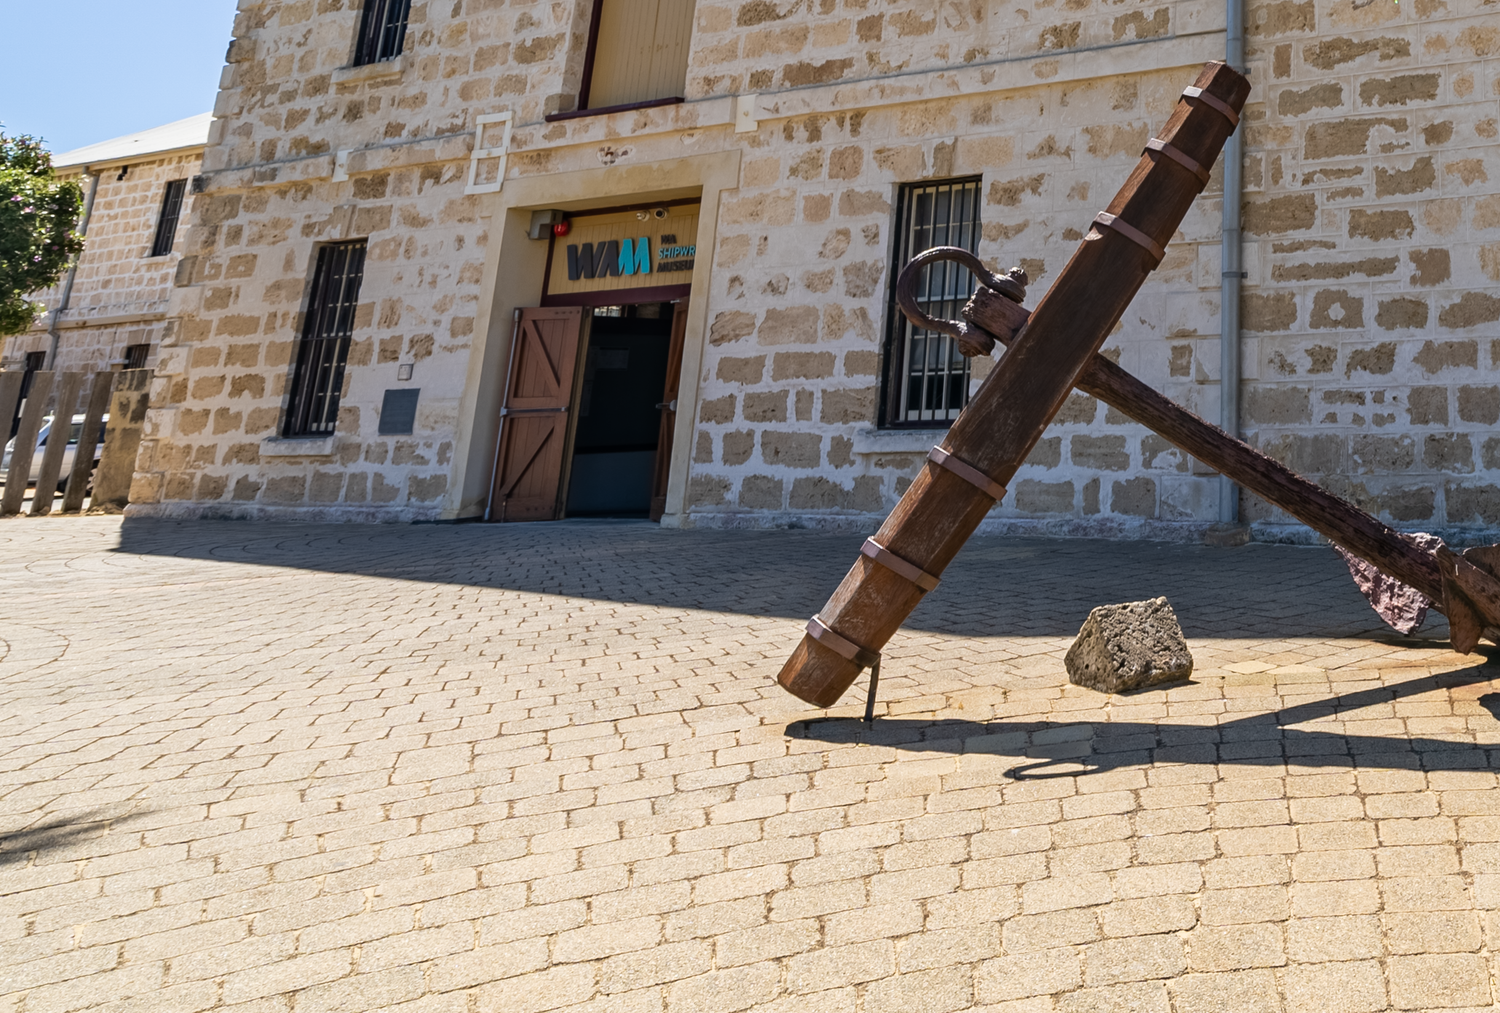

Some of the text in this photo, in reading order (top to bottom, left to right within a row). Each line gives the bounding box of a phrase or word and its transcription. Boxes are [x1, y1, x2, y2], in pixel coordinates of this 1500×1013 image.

[661, 234, 677, 245] WA
[566, 237, 650, 280] WAM
[658, 245, 696, 259] SHIPWR
[656, 259, 695, 273] MUSEU
